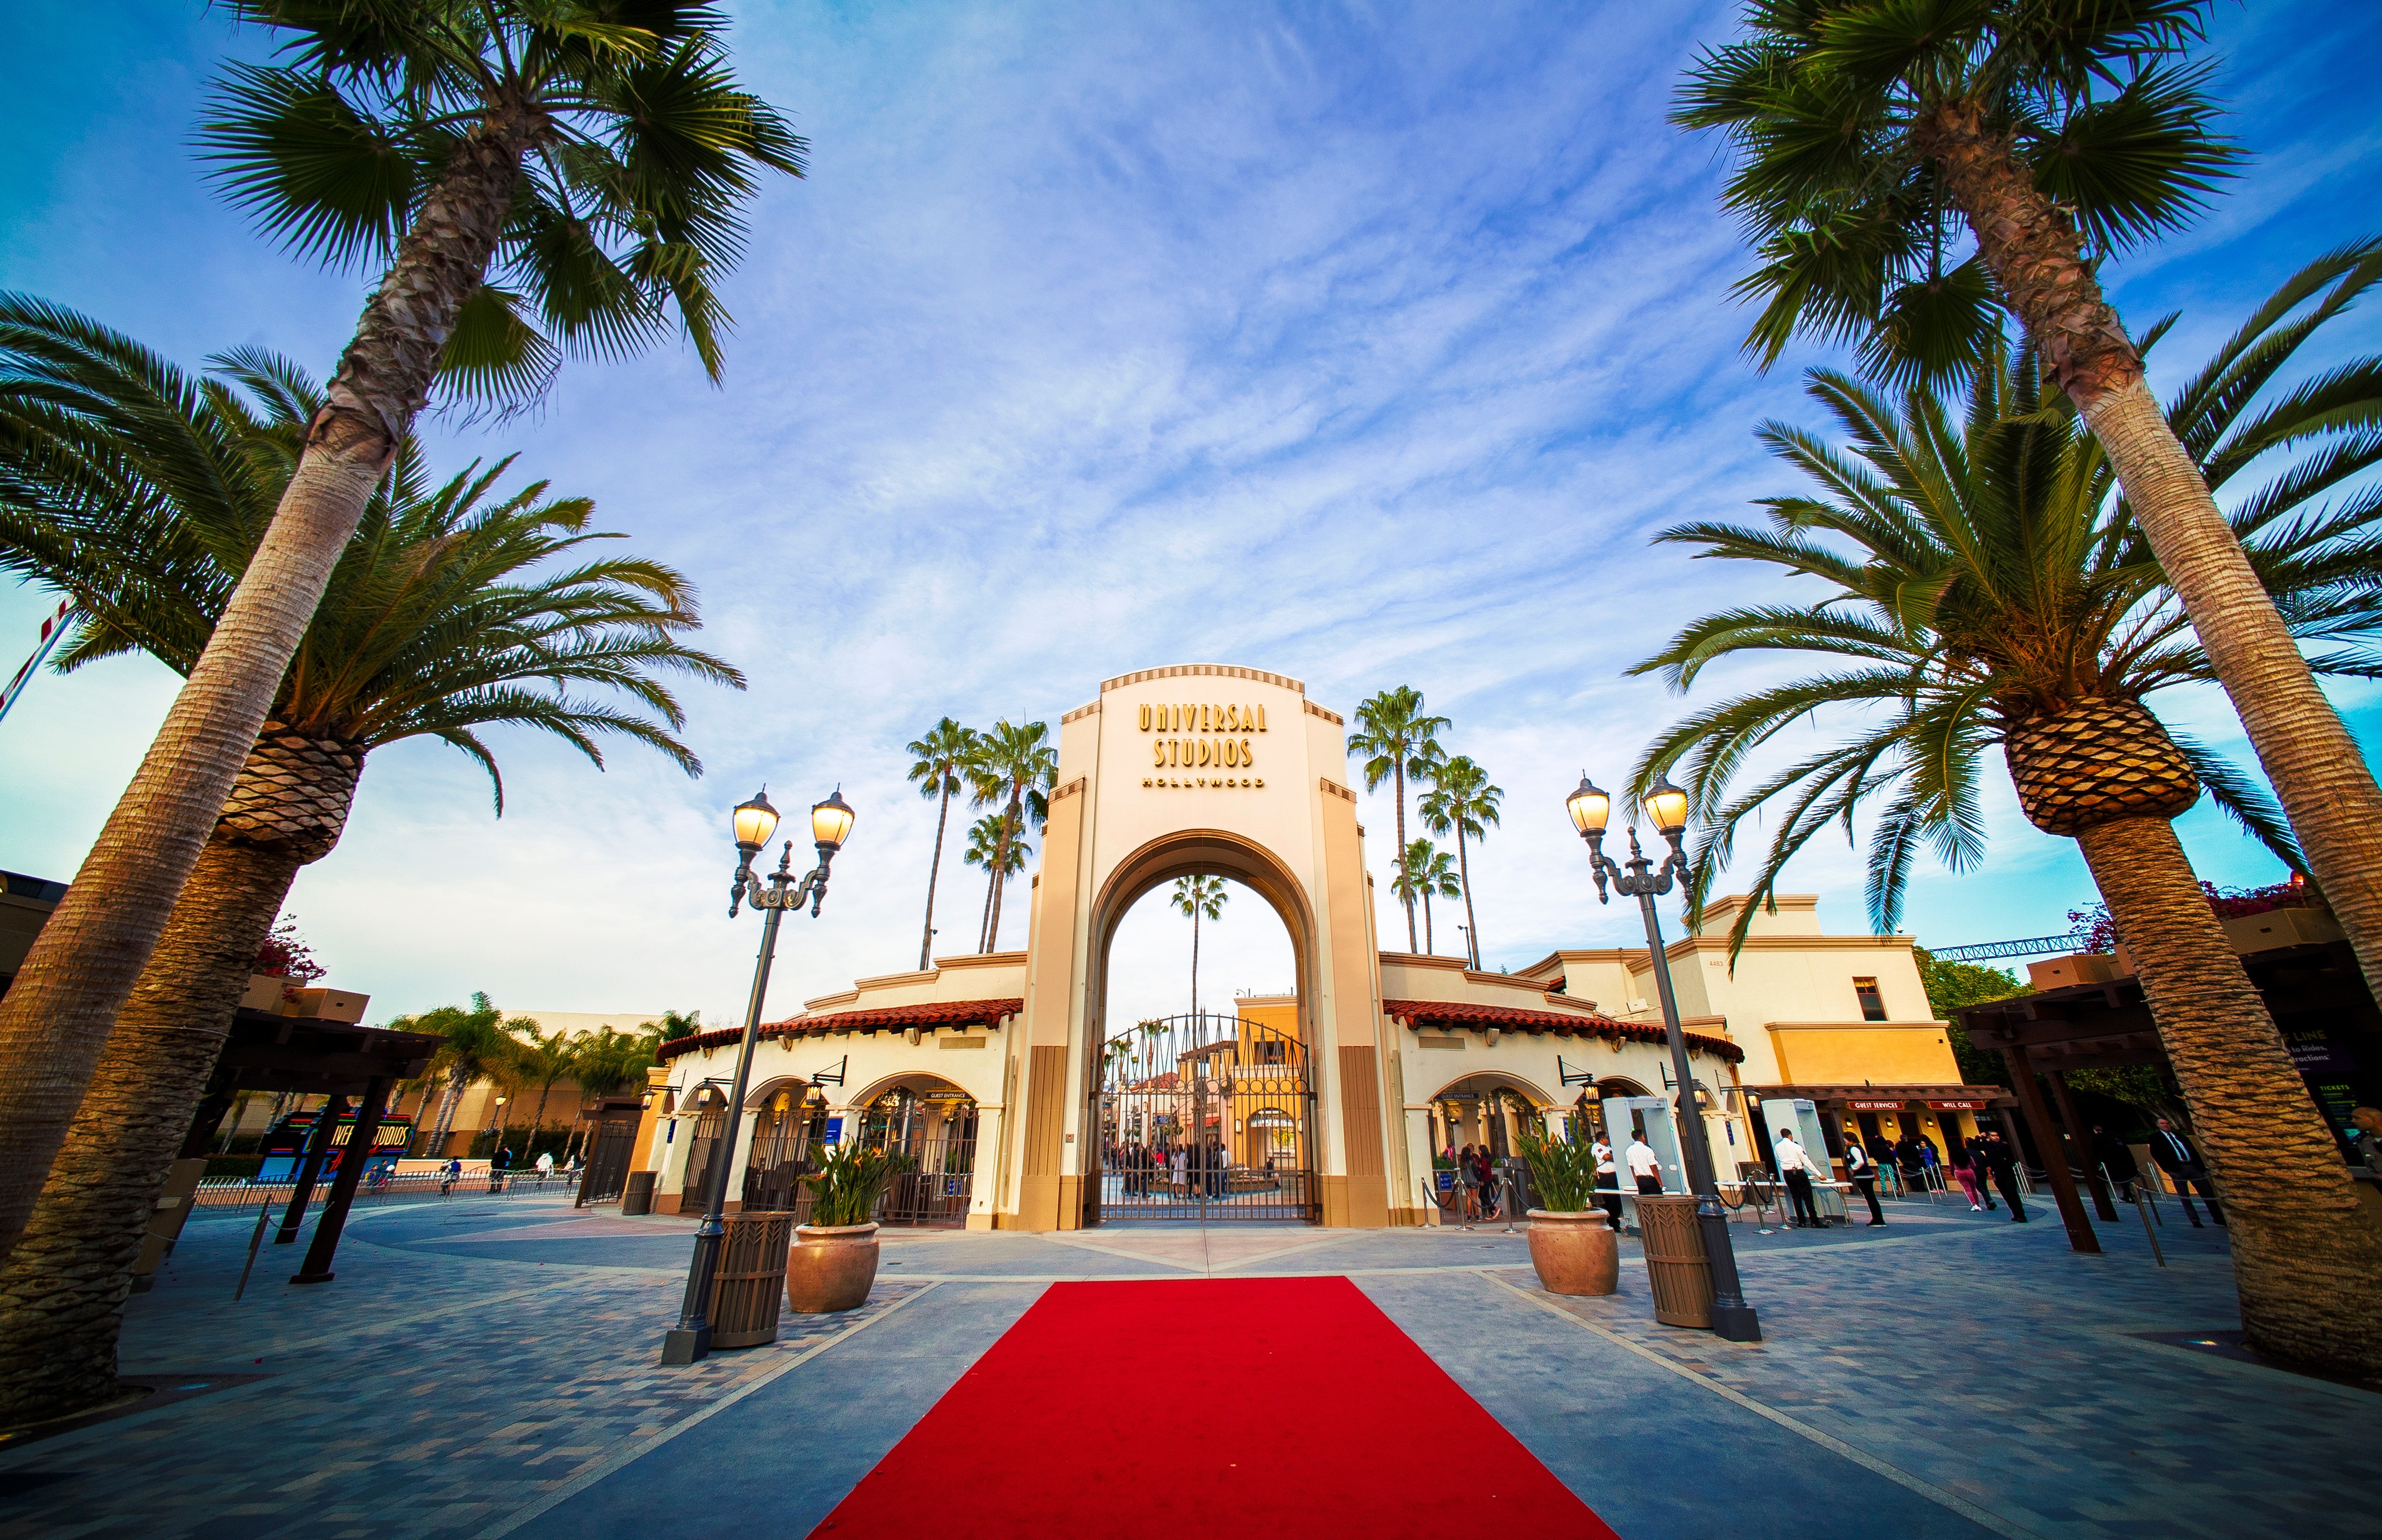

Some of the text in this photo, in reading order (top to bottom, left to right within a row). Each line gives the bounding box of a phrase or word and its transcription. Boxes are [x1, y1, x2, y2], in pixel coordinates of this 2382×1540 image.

[1139, 704, 1267, 731] UNIVERSAL
[1154, 739, 1253, 767] STUDIOS
[1142, 778, 1264, 787] HOLLYWOOD
[2292, 1030, 2328, 1042] LINE
[2301, 1044, 2328, 1052] Rides,
[371, 1126, 409, 1146] TUDIOS
